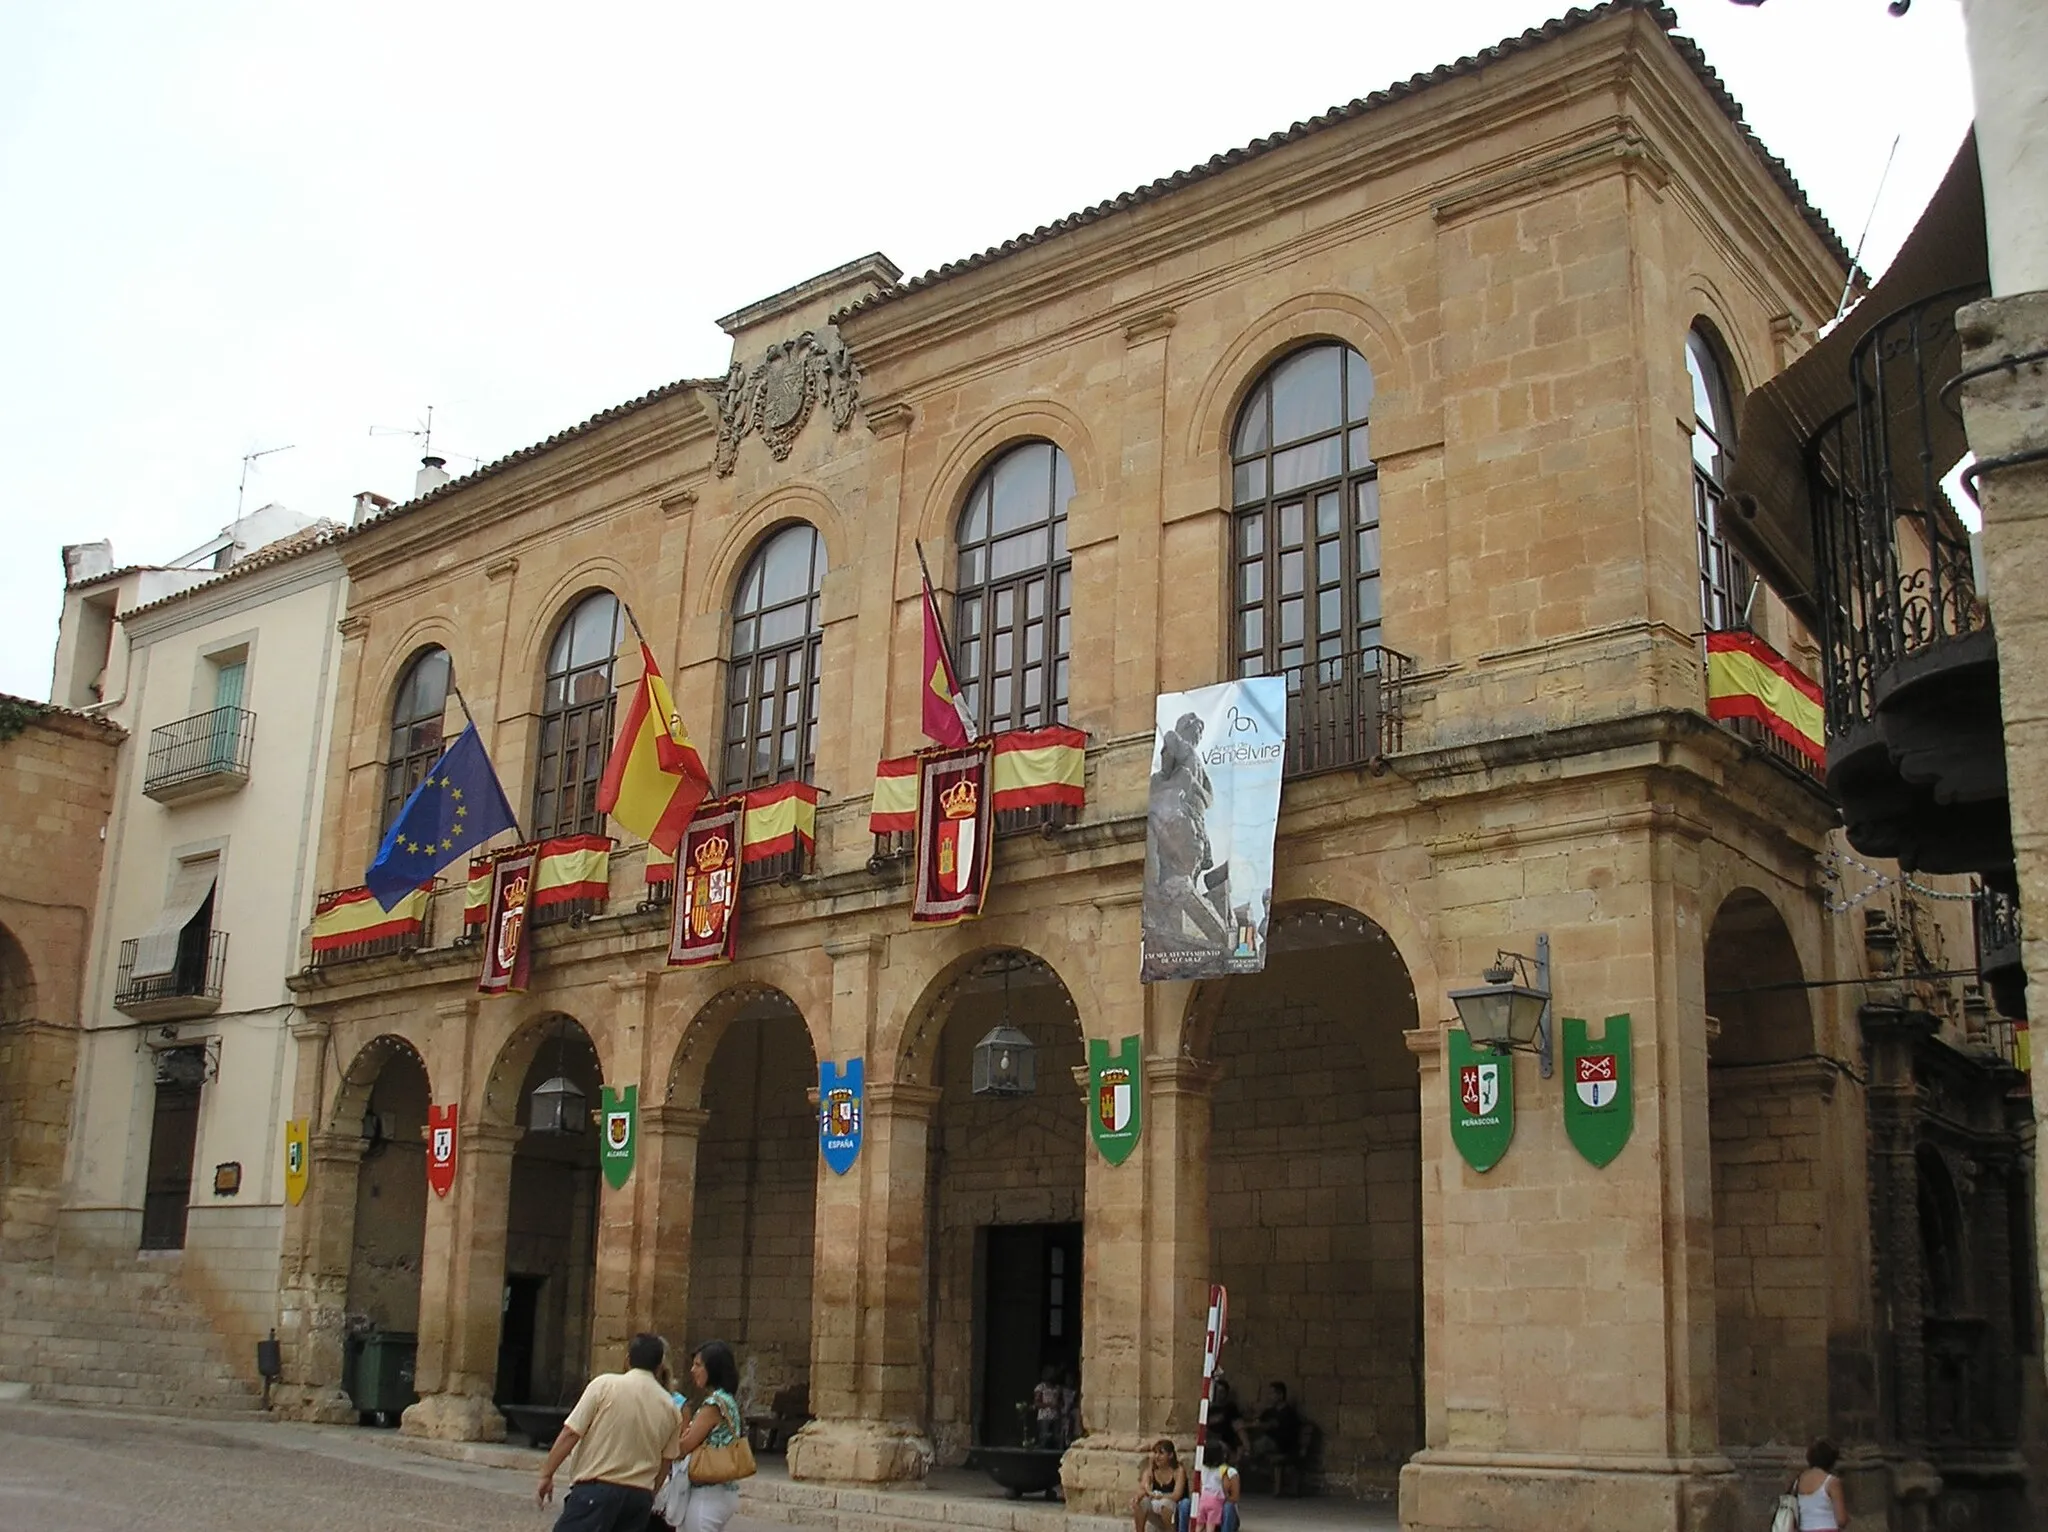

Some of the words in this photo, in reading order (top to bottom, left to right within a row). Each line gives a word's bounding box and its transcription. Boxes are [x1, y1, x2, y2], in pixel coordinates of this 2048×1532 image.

[1461, 1116, 1500, 1127] PEÑASCOSA
[828, 1138, 854, 1149] ESPAÑA
[606, 1150, 630, 1158] ALCARAZ
